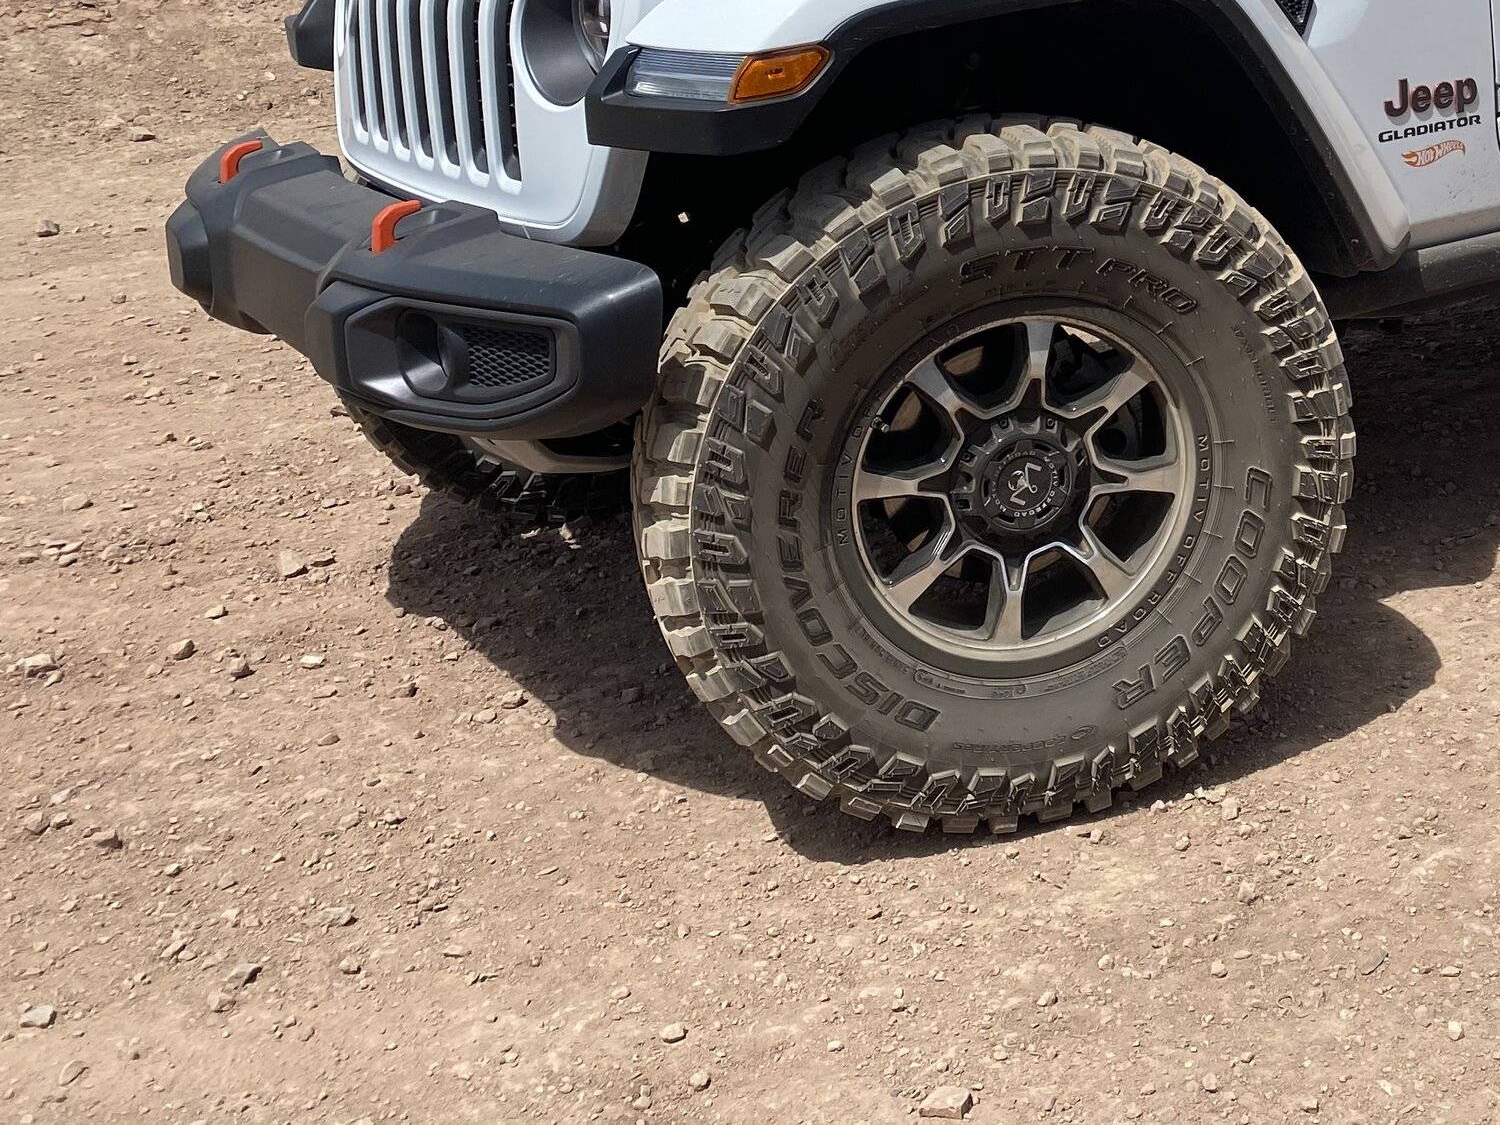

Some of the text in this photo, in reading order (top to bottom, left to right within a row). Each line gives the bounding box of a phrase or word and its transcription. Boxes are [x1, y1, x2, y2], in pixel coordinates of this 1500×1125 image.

[1378, 115, 1481, 143] GLADIATOR
[1384, 77, 1478, 117] Jeep
[959, 244, 1095, 285] STT
[1095, 257, 1198, 314] PRO
[837, 454, 853, 546] MOTIV
[1193, 434, 1211, 523] MOTIV
[775, 396, 942, 733] DISCOVERER
[1111, 465, 1274, 711] COOPER
